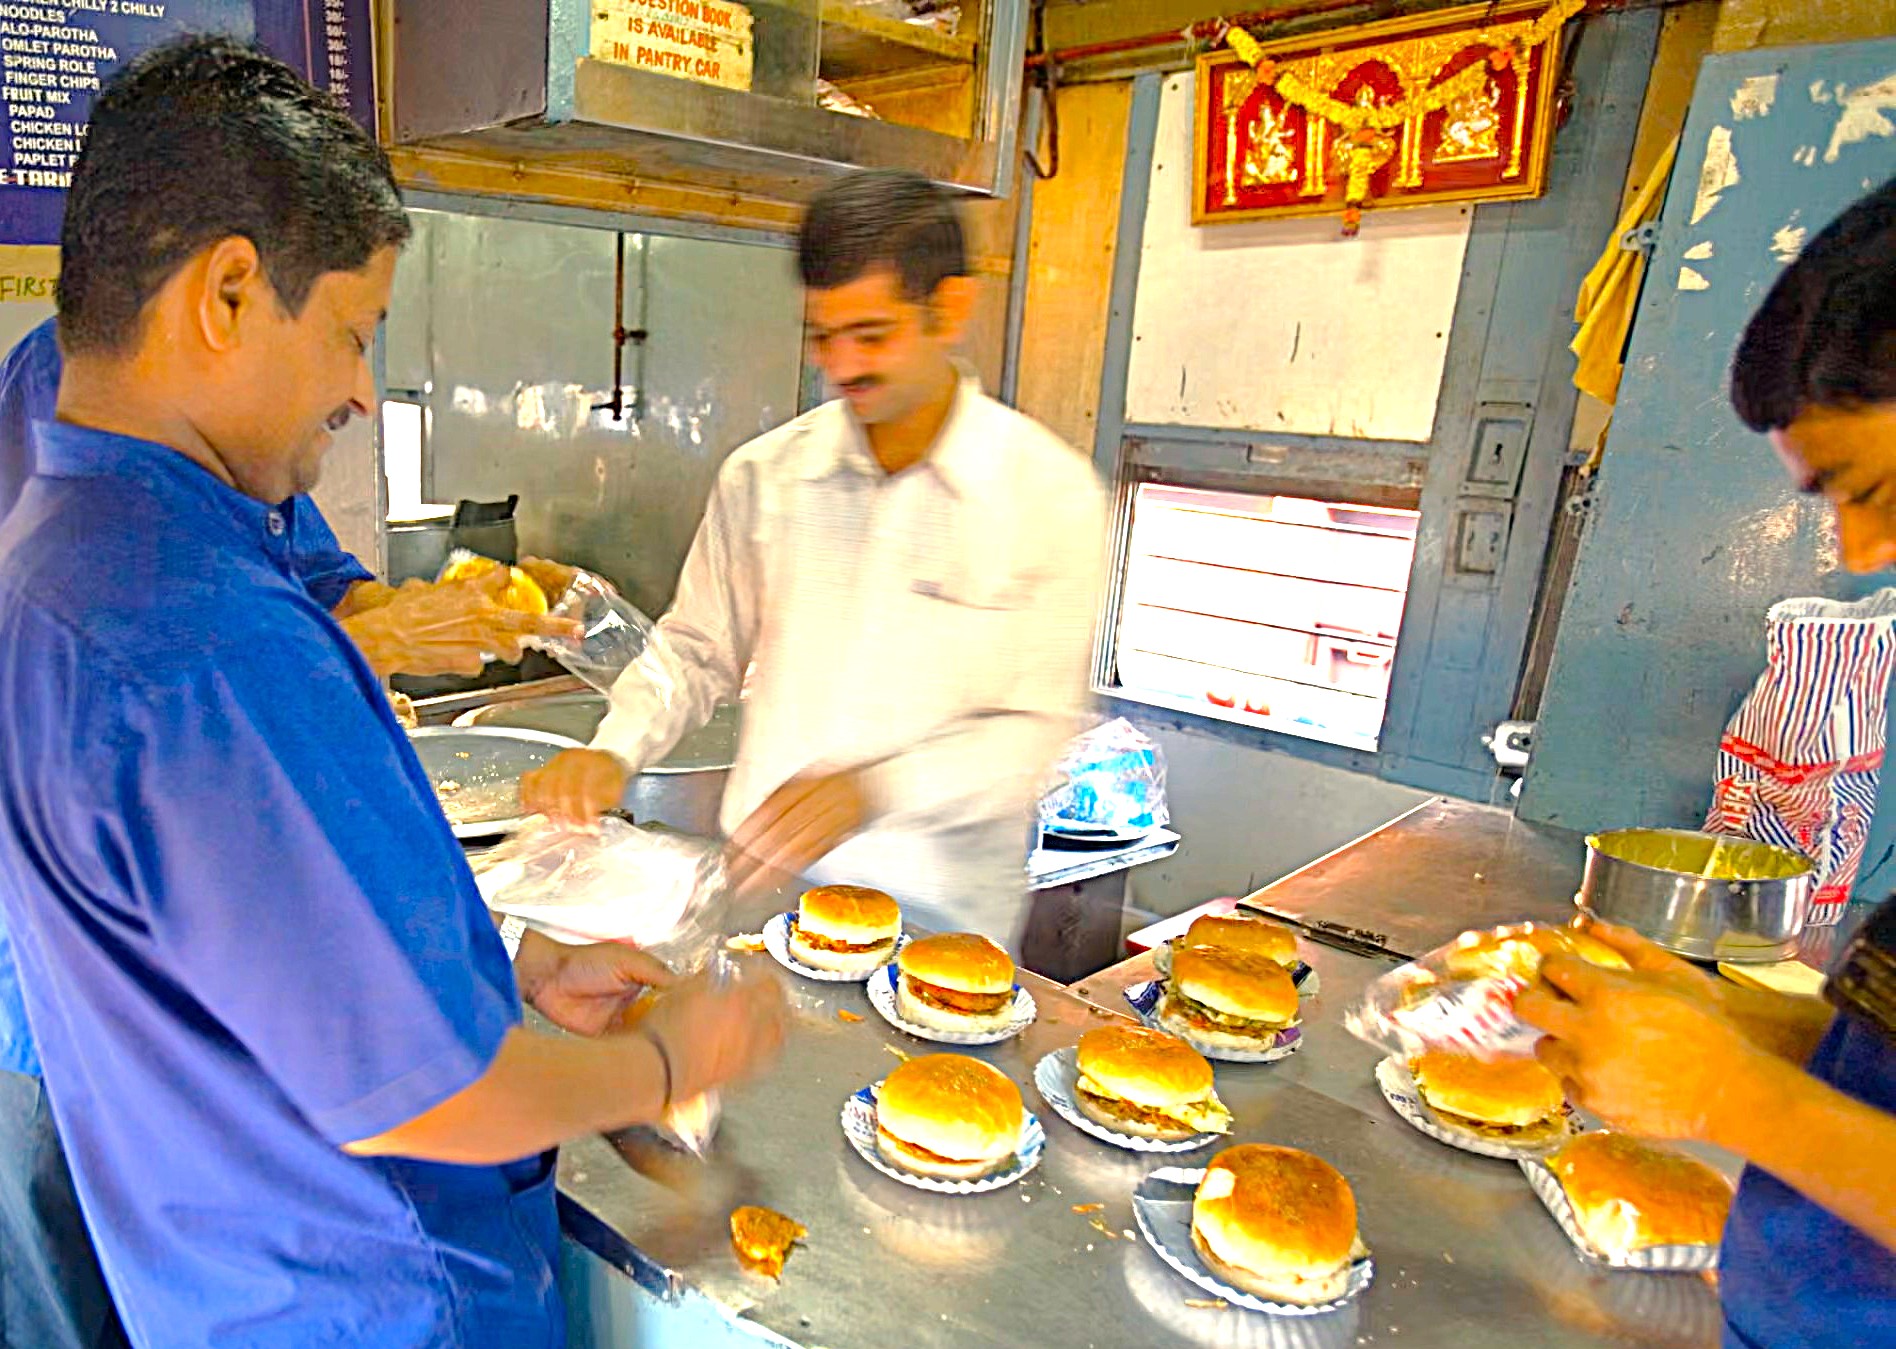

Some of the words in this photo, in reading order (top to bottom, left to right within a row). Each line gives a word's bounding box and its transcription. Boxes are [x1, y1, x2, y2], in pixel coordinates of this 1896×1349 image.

[0, 4, 65, 23] NOODLES
[121, 2, 165, 17] CHILLY
[631, 0, 699, 19] ESTION
[703, 6, 732, 29] BOOK
[628, 17, 643, 34] IS
[648, 21, 718, 52] AVAILABLE
[2, 38, 49, 54] OMLET
[53, 43, 117, 59] PAROTHA
[3, 56, 56, 71] SPRING
[60, 59, 96, 74] ROLE
[614, 41, 629, 60] IN
[636, 46, 692, 72] PANTRY
[695, 58, 721, 79] CAR
[5, 71, 57, 86] FINGER
[60, 75, 100, 90] CHIPS
[2, 86, 42, 102] FRUIT
[46, 90, 71, 104] MIX
[9, 104, 55, 119] PAPAD
[10, 120, 72, 136] CHICKEN
[12, 137, 73, 151] CHICKEN
[14, 152, 66, 167] PAPLET
